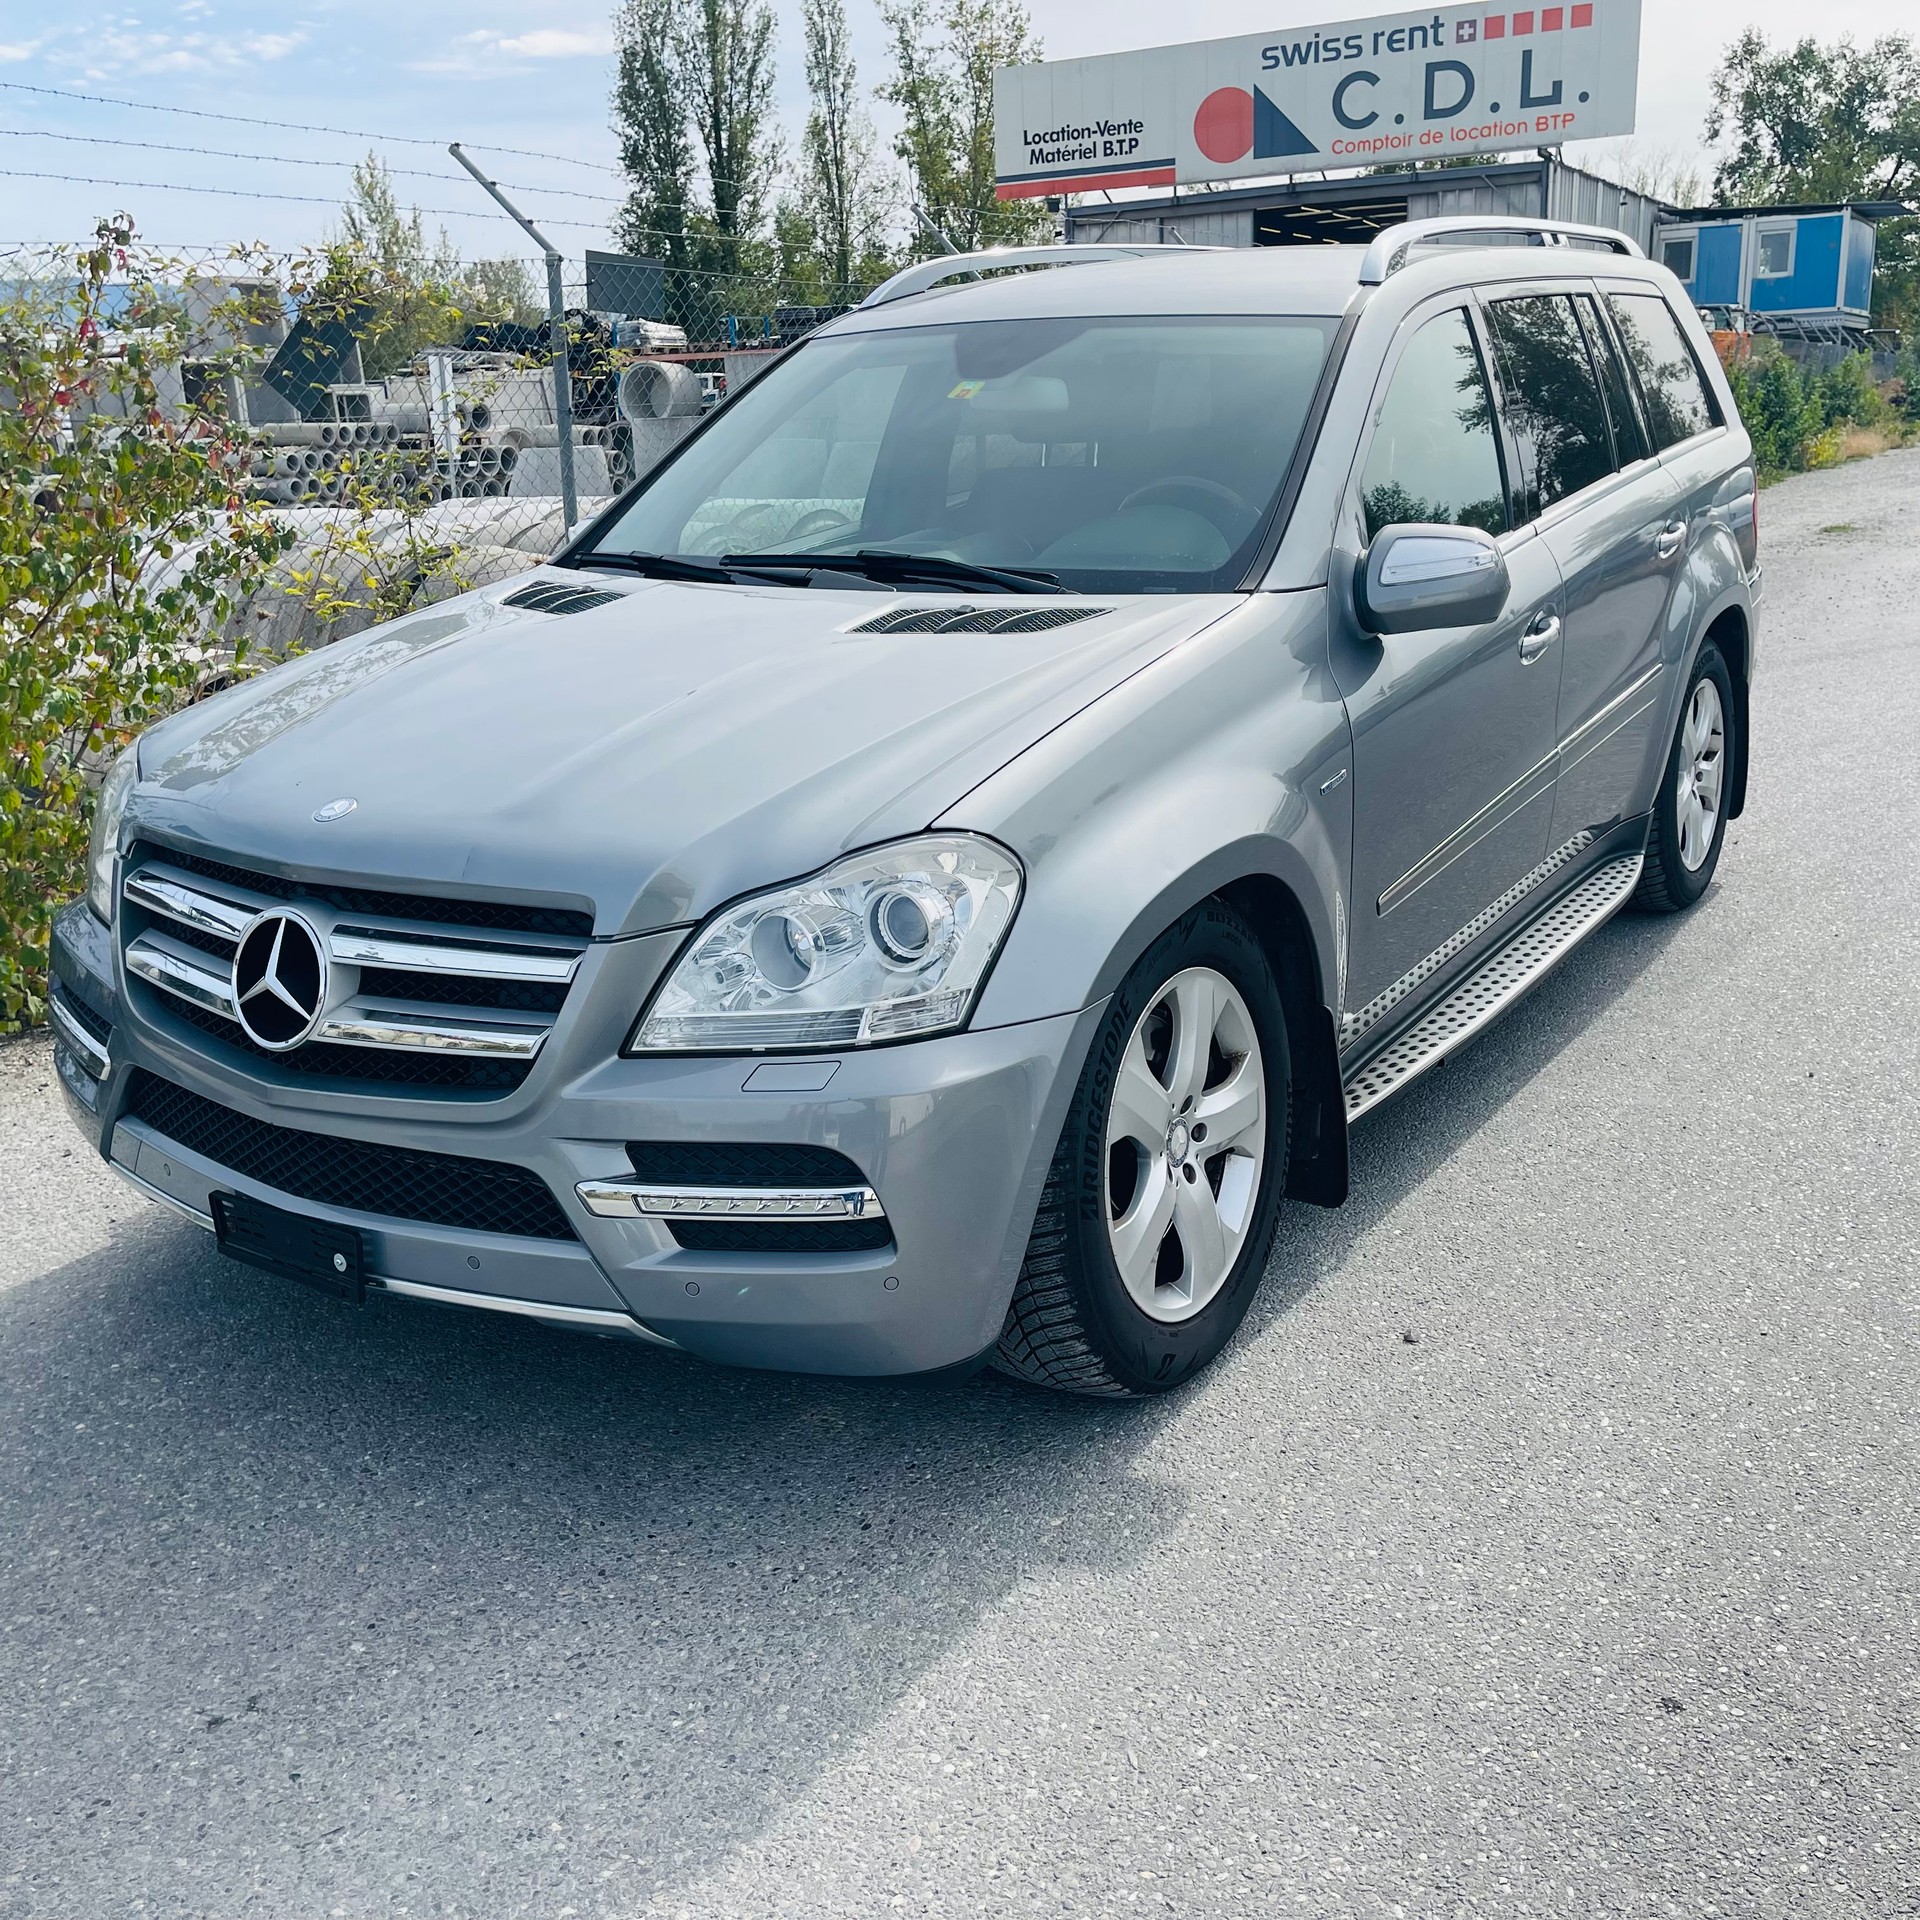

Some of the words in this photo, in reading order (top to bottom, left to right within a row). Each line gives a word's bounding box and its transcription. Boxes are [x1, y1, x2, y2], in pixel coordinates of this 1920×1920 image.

[1261, 32, 1364, 71] swiss
[1372, 15, 1446, 56] rent
[1023, 118, 1144, 146] Location-Vente
[1029, 140, 1097, 165] Matériel
[1103, 137, 1139, 157] B.T.P
[1331, 132, 1414, 156] Comptoir
[1419, 129, 1444, 146] de
[1450, 119, 1529, 142] location
[1535, 112, 1576, 133] BTP
[1080, 993, 1132, 1223] BRIDGESTONE
